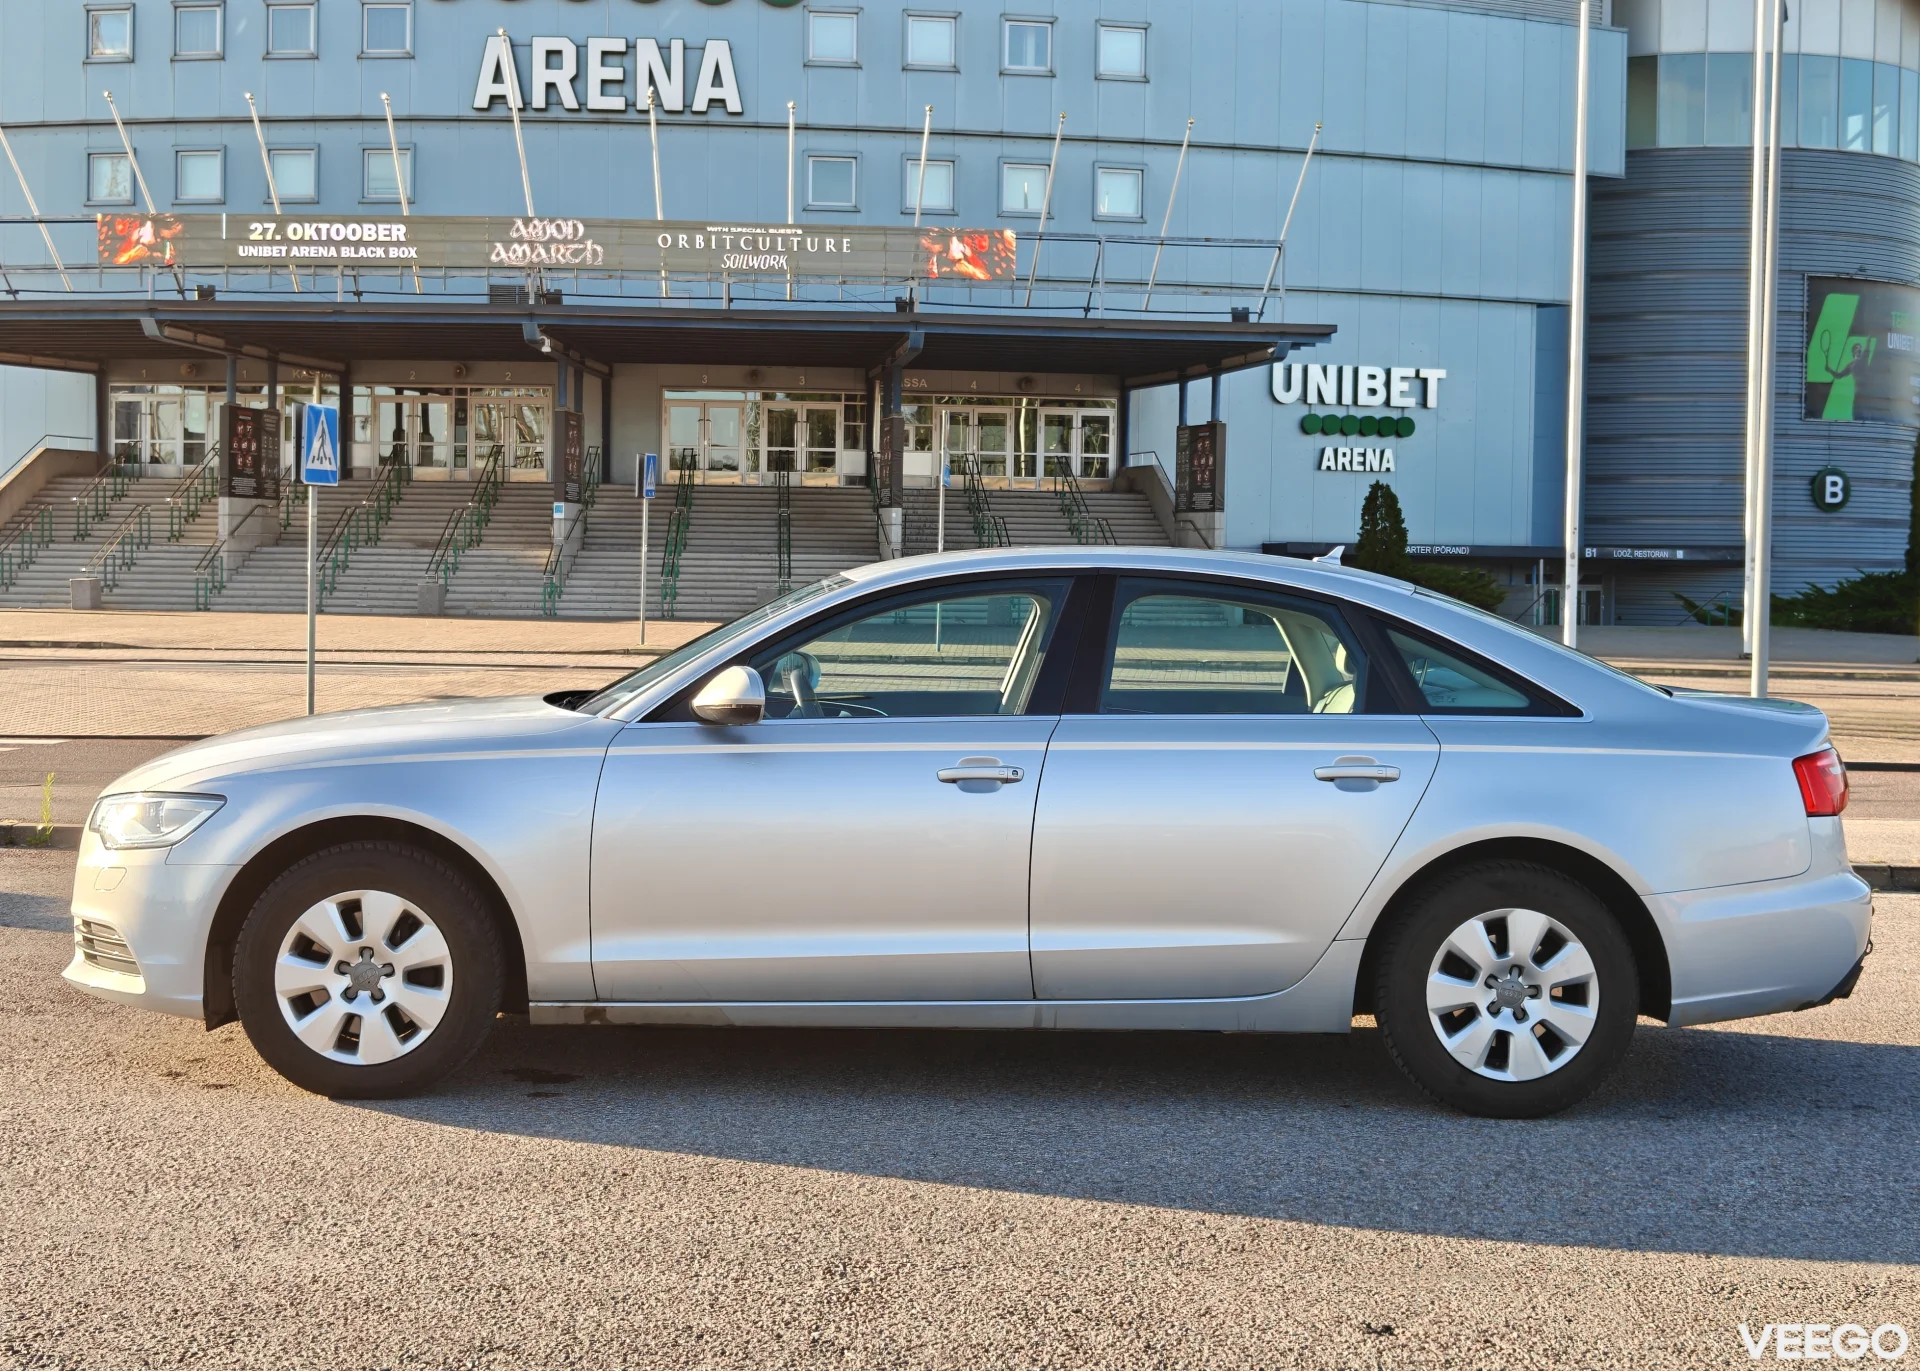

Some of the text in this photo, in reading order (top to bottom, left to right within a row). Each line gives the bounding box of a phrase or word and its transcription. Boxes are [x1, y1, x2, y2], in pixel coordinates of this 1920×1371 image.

[472, 36, 743, 114] ARENA
[249, 222, 407, 242] 27. OKTOOBER
[238, 245, 418, 259] UNIBET ARENA BLACK BOX
[721, 253, 788, 270] SOILWORK
[409, 370, 416, 380] 2
[505, 372, 512, 381] 2
[701, 374, 708, 384] 3
[798, 376, 806, 386] 3
[970, 380, 977, 390] 4
[1271, 362, 1447, 409] UNIBET
[1074, 383, 1082, 393] 4
[1319, 446, 1396, 472] ARENA
[1825, 475, 1844, 504] B
[1405, 545, 1431, 554] ARTER
[1585, 547, 1597, 558] B1
[1634, 549, 1669, 559] RESTORAN
